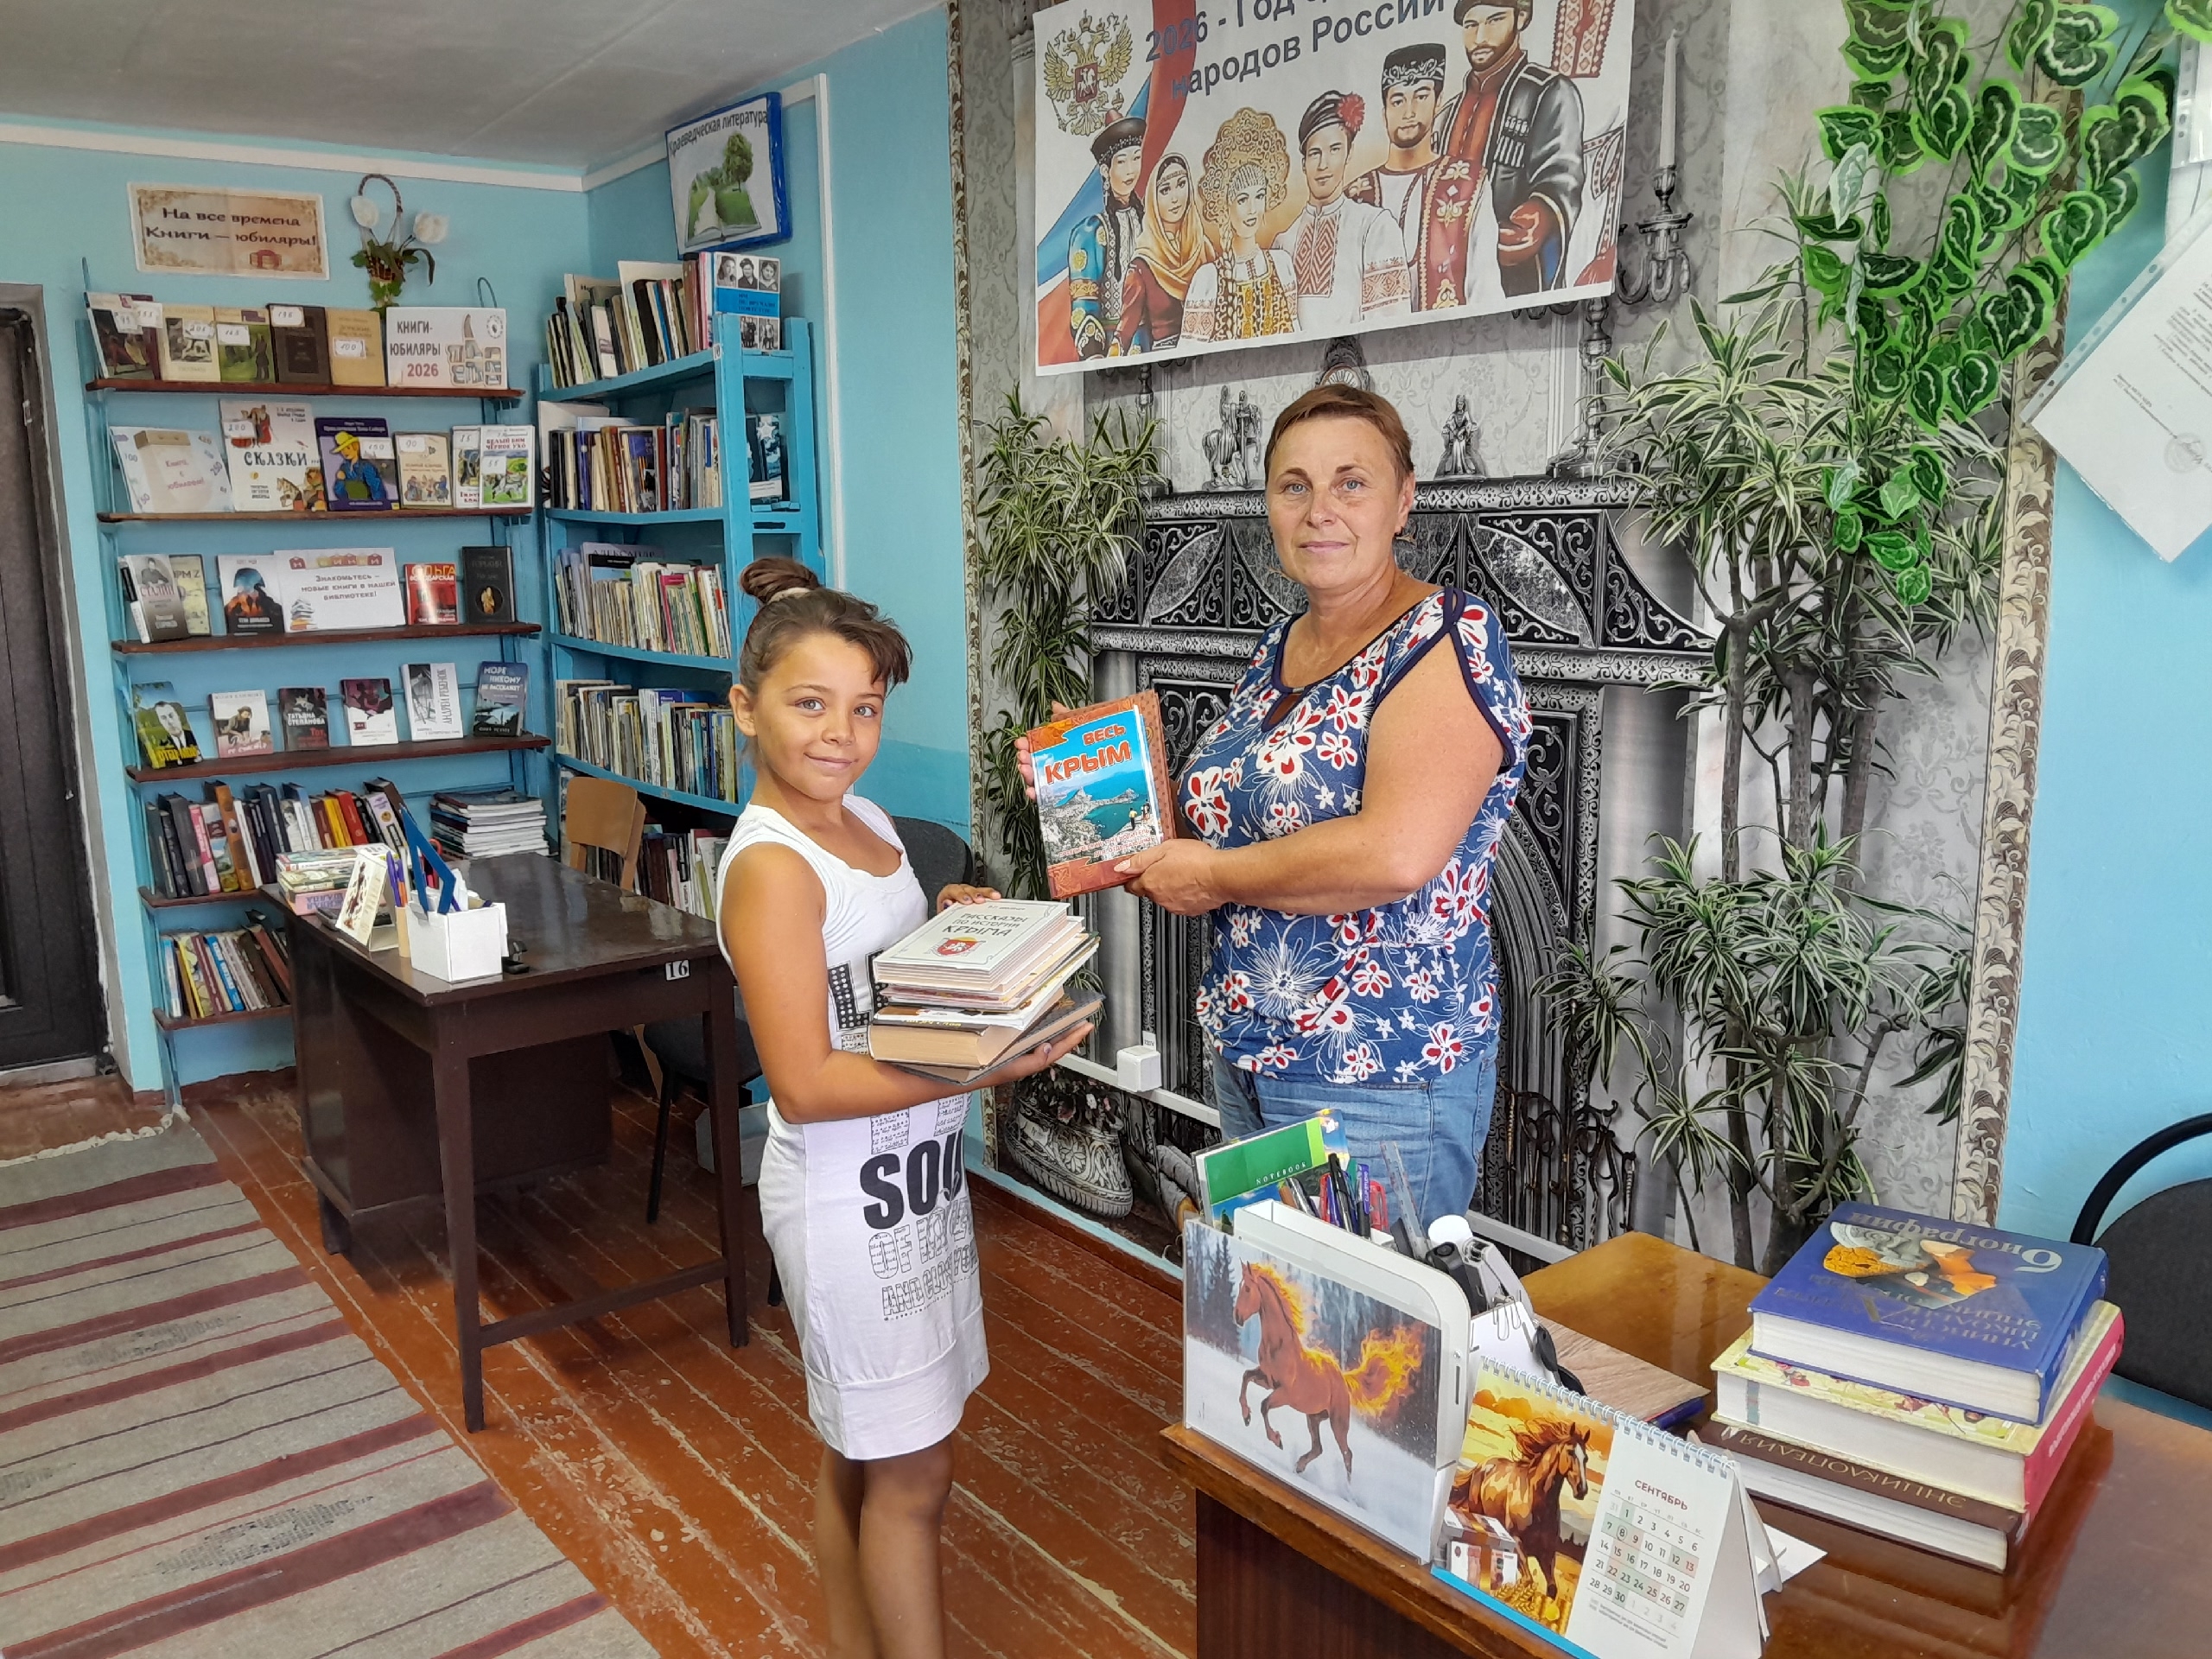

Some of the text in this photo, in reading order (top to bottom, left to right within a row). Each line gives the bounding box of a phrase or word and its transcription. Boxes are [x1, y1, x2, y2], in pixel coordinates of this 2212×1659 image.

[1145, 10, 1209, 63] 2026
[1172, 0, 1445, 99] народов России
[669, 110, 768, 158] Краеведческая литература
[162, 207, 301, 227] На все времена
[145, 226, 211, 240] Книги
[235, 231, 317, 247] юбиляры!
[397, 320, 434, 334] КНИГИ-
[390, 342, 441, 357] ЮБИЛЯРЫ
[407, 363, 439, 378] 2026
[244, 451, 308, 466] СКАЗКИ
[1082, 723, 1127, 747] ВЕСЬ
[1044, 741, 1133, 785] КРЫМ
[960, 912, 1029, 924] РАССКАЗЫ
[970, 919, 1021, 928] ИСТОРИИ
[942, 925, 1013, 937] КРЫМА
[668, 959, 689, 978] 16
[1255, 1160, 1308, 1185] NOTEBOOK
[1634, 1479, 1688, 1510] СЕНТЯБРЬ
[1625, 1509, 1630, 1518] 1
[1637, 1516, 1643, 1524] 2
[1650, 1522, 1656, 1531] 3
[1678, 1535, 1684, 1544] 5
[1692, 1542, 1698, 1551] 6
[1619, 1528, 1625, 1537] 8
[1632, 1535, 1639, 1544] 9
[1644, 1541, 1653, 1551] 10
[1659, 1548, 1666, 1558] 11
[1672, 1554, 1681, 1565] 12
[1686, 1560, 1694, 1572] 13
[1600, 1540, 1691, 1592] 14 15 16 17 18 19 20
[1589, 1578, 1600, 1589] 28
[1602, 1585, 1613, 1595] 29
[1614, 1591, 1625, 1603] 30
[1596, 1559, 1685, 1611] 21 22 23 24 25 26 27
